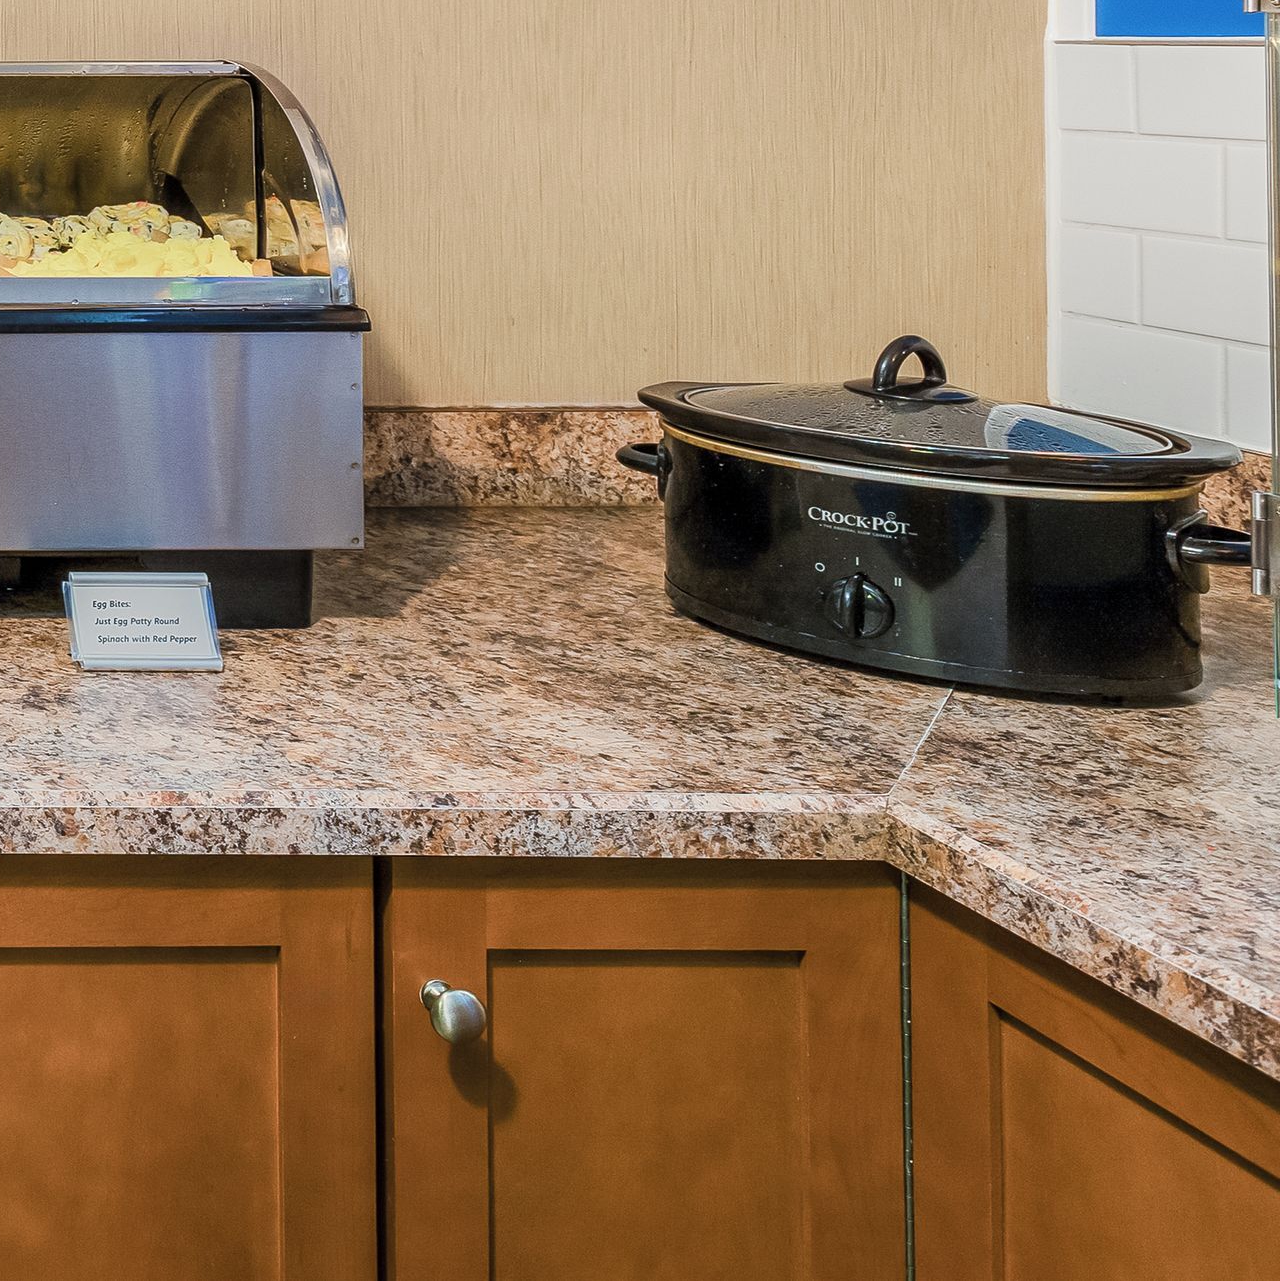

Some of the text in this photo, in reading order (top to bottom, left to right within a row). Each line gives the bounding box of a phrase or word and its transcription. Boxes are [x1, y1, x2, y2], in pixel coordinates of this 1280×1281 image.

[92, 600, 132, 610] Egg Bites:
[95, 617, 180, 626] Just Egg Patty Round
[97, 635, 197, 645] Spinach with Red Pepper
